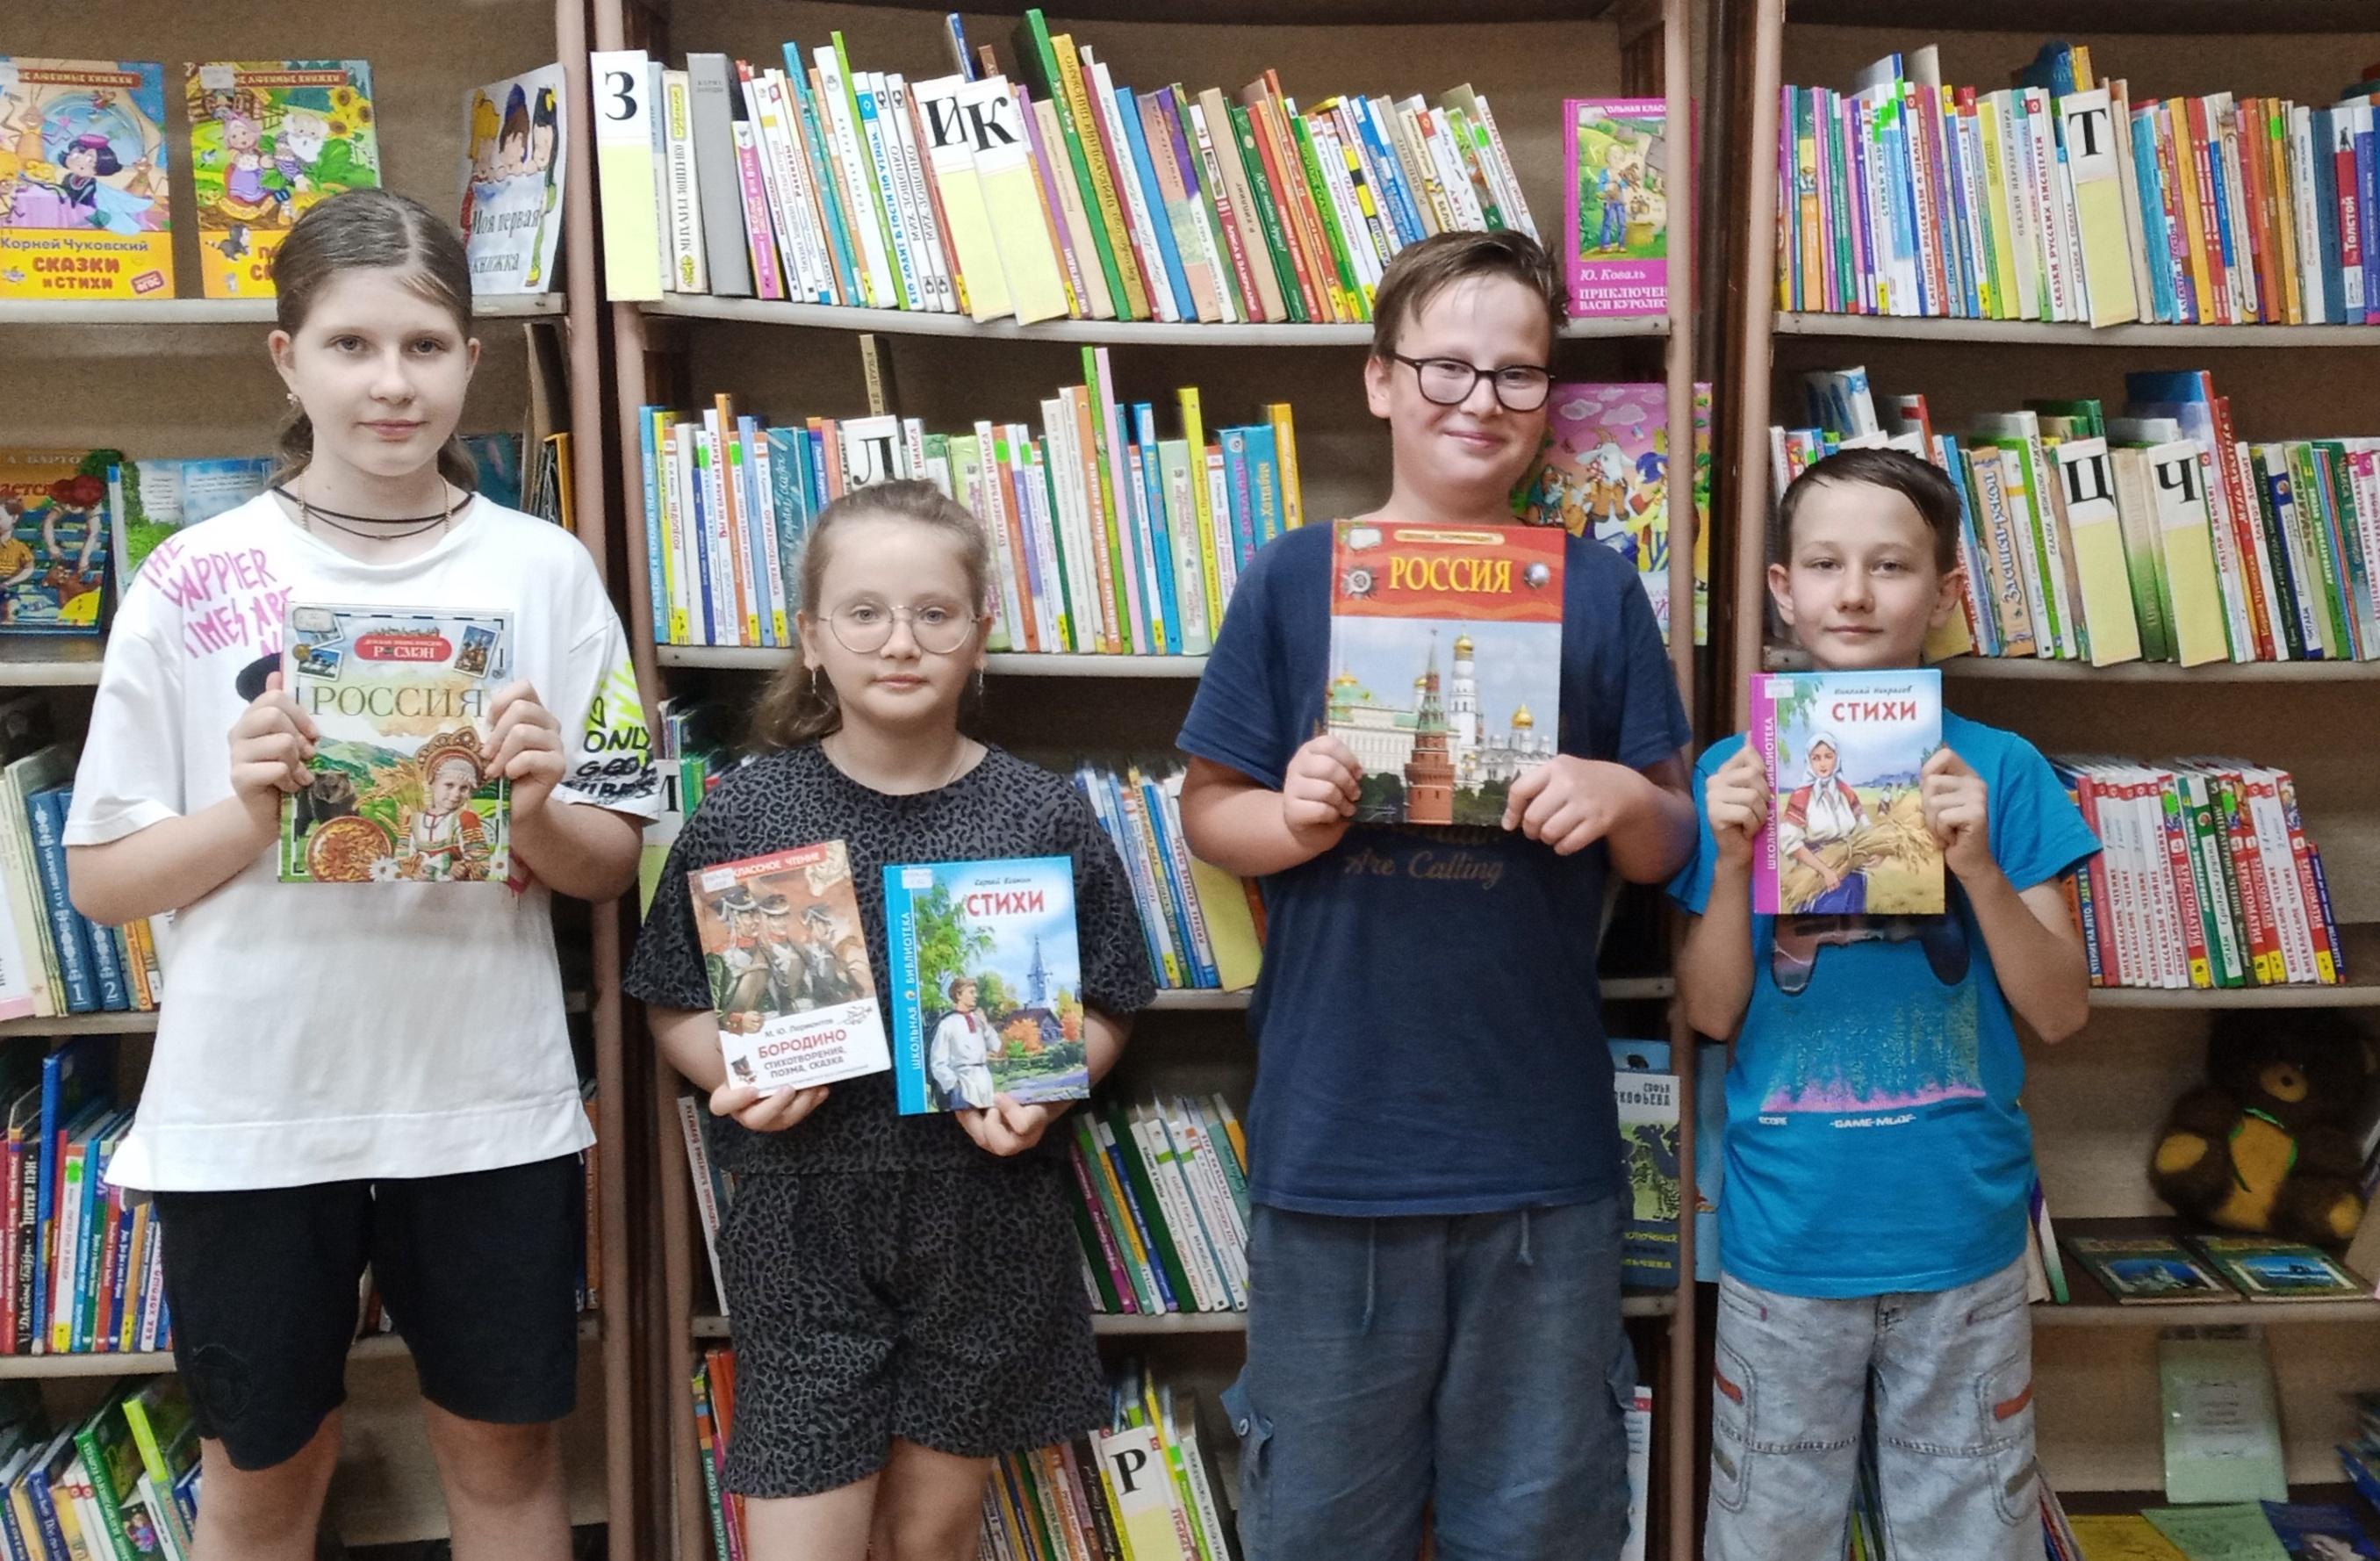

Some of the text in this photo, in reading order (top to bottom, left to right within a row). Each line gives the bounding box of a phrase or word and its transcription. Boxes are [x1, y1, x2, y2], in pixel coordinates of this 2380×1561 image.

[1063, 55, 1090, 119] ПИНОККИО
[963, 96, 1020, 153] К
[2068, 108, 2108, 157] Т
[1911, 135, 1920, 172] ШКОЛЕ
[674, 144, 693, 251] МИХАИЛ ЗОЩЕНКО
[890, 146, 913, 209] ЗОЩЕНКО
[906, 145, 928, 208] ЗОЩЕНКО
[498, 210, 540, 237] первая
[888, 194, 902, 228] ГОСТИ
[1917, 188, 1931, 248] РАССКАЗЫ
[2035, 136, 2064, 308] СКАЗКИ РУССКИХ ПИСАТЕЛЕЙ
[2341, 196, 2357, 252] Толстой
[0, 238, 148, 252] Корней Чуковский
[897, 241, 914, 279] ХОДИТ
[1225, 225, 1239, 252] АЛИСА
[32, 257, 120, 273] СКАЗКИ
[55, 277, 112, 290] СТИХИ
[472, 253, 519, 273] книжка
[1064, 248, 1083, 292] ПОГОДИ!
[1581, 269, 1646, 281] Ю. Коваль
[1923, 252, 1937, 306] СМЕШНЫЕ
[1579, 299, 1611, 311] ВАСИ
[2063, 454, 2115, 506] Ц
[2154, 458, 2201, 503] Ч
[1389, 557, 1512, 593] РОССИЯ
[312, 686, 486, 717] РОССИЯ
[1831, 701, 1916, 722] СТИХИ
[1766, 717, 1775, 788] БИБЛИОТЕКА
[786, 852, 821, 865] ЧТЕНИЕ
[1344, 847, 1505, 891] Are Calling
[967, 889, 1045, 917] СТИХИ
[2179, 863, 2202, 947] ХРЕСТОМАТИЯ
[2240, 860, 2262, 944] ХРЕСТОМАТИЯ
[2156, 918, 2174, 976] РАССКАЗЫ
[104, 982, 119, 1000] 2
[905, 912, 921, 1070] ШКОЛЬНАЯ БИБЛИОТЕКА
[759, 1029, 847, 1059] БОРОДИНО
[809, 1056, 844, 1070] СКАЗКА
[24, 1160, 36, 1183] ПЭН
[19, 1187, 35, 1227] ПИТЕР
[149, 1270, 162, 1315] ХОРОШО
[706, 1457, 719, 1504] ИСТОРИИ
[1111, 1447, 1147, 1495] Р
